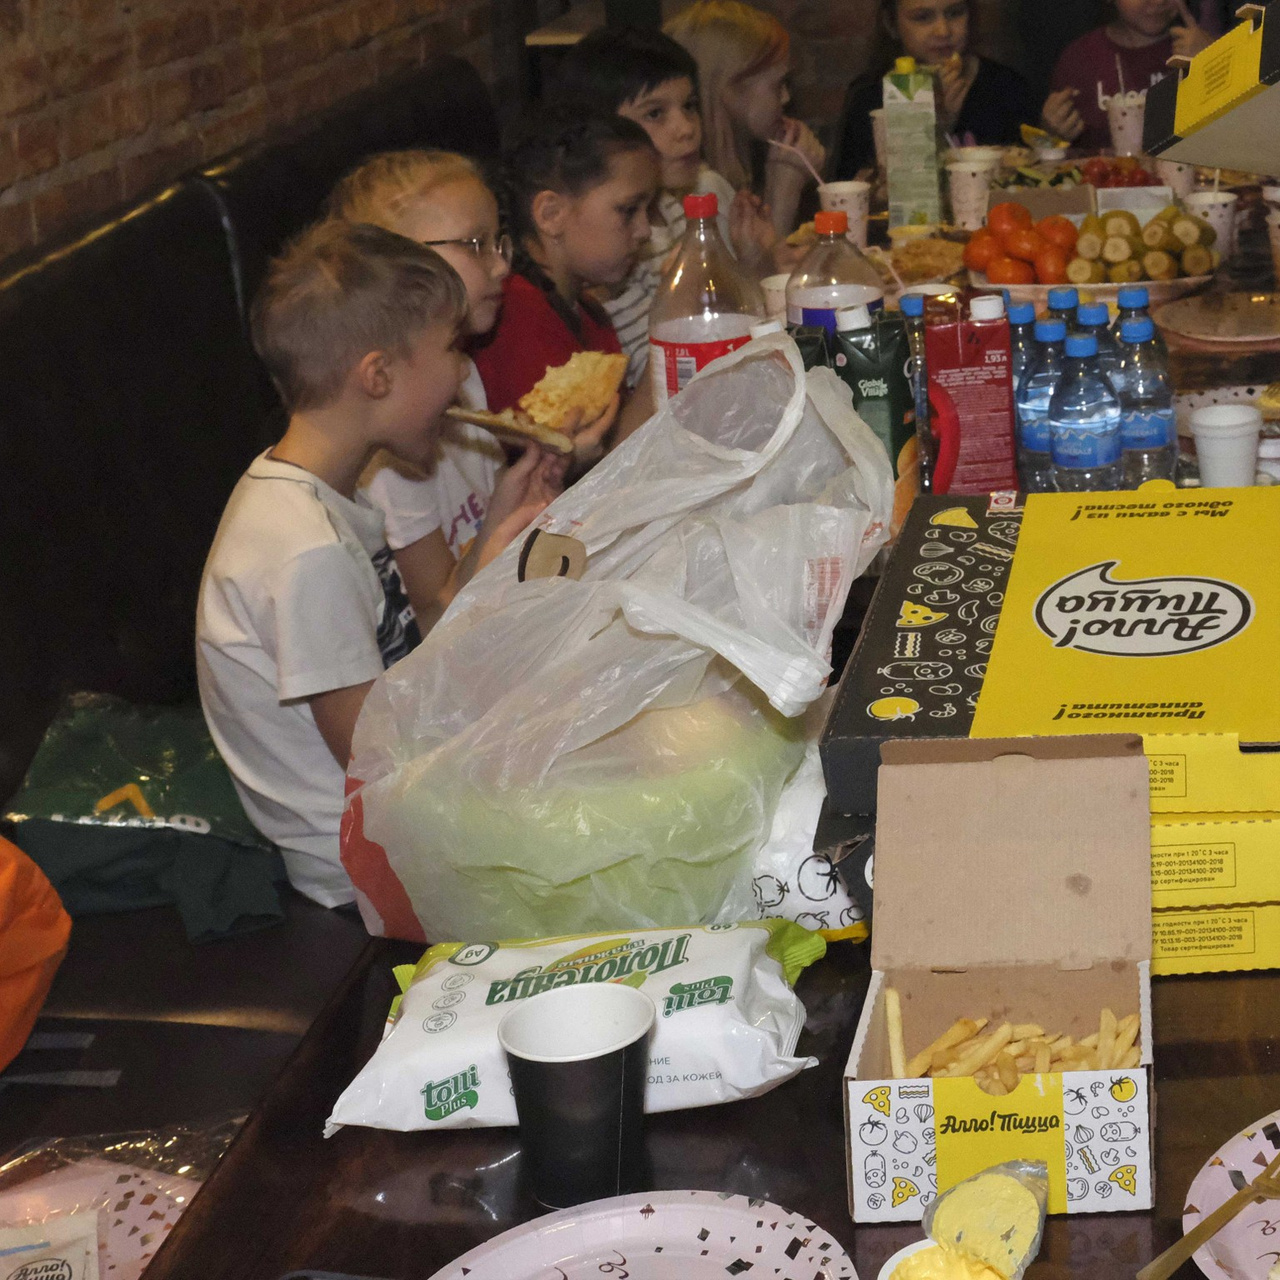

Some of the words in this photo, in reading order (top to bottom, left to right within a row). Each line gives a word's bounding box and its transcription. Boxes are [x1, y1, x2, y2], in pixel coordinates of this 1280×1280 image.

[858, 377, 884, 389] Global
[1162, 501, 1234, 509] одного
[1193, 509, 1230, 517] Мы
[1055, 588, 1228, 616] Пицца
[1055, 615, 1221, 647] Алло!
[1151, 858, 1224, 868] 5.19-001-20134100-2018
[1151, 867, 1224, 877] .15-003-20134100-2018
[1159, 877, 1215, 885] сертифицирован
[1162, 920, 1191, 928] годности
[1180, 943, 1235, 951] сертифицирован
[557, 939, 645, 969] влажные
[485, 933, 690, 1006] Полотенца
[683, 979, 715, 991] Plus
[663, 985, 735, 1017] tolli
[649, 1056, 671, 1065] НИЕ
[647, 1075, 664, 1084] ОД
[666, 1075, 680, 1083] ЗА
[682, 1071, 723, 1082] КОЖЕЙ
[421, 1065, 480, 1109] tolli
[440, 1096, 467, 1116] Plus
[940, 1111, 997, 1135] Алло!
[999, 1113, 1060, 1135] Пицца
